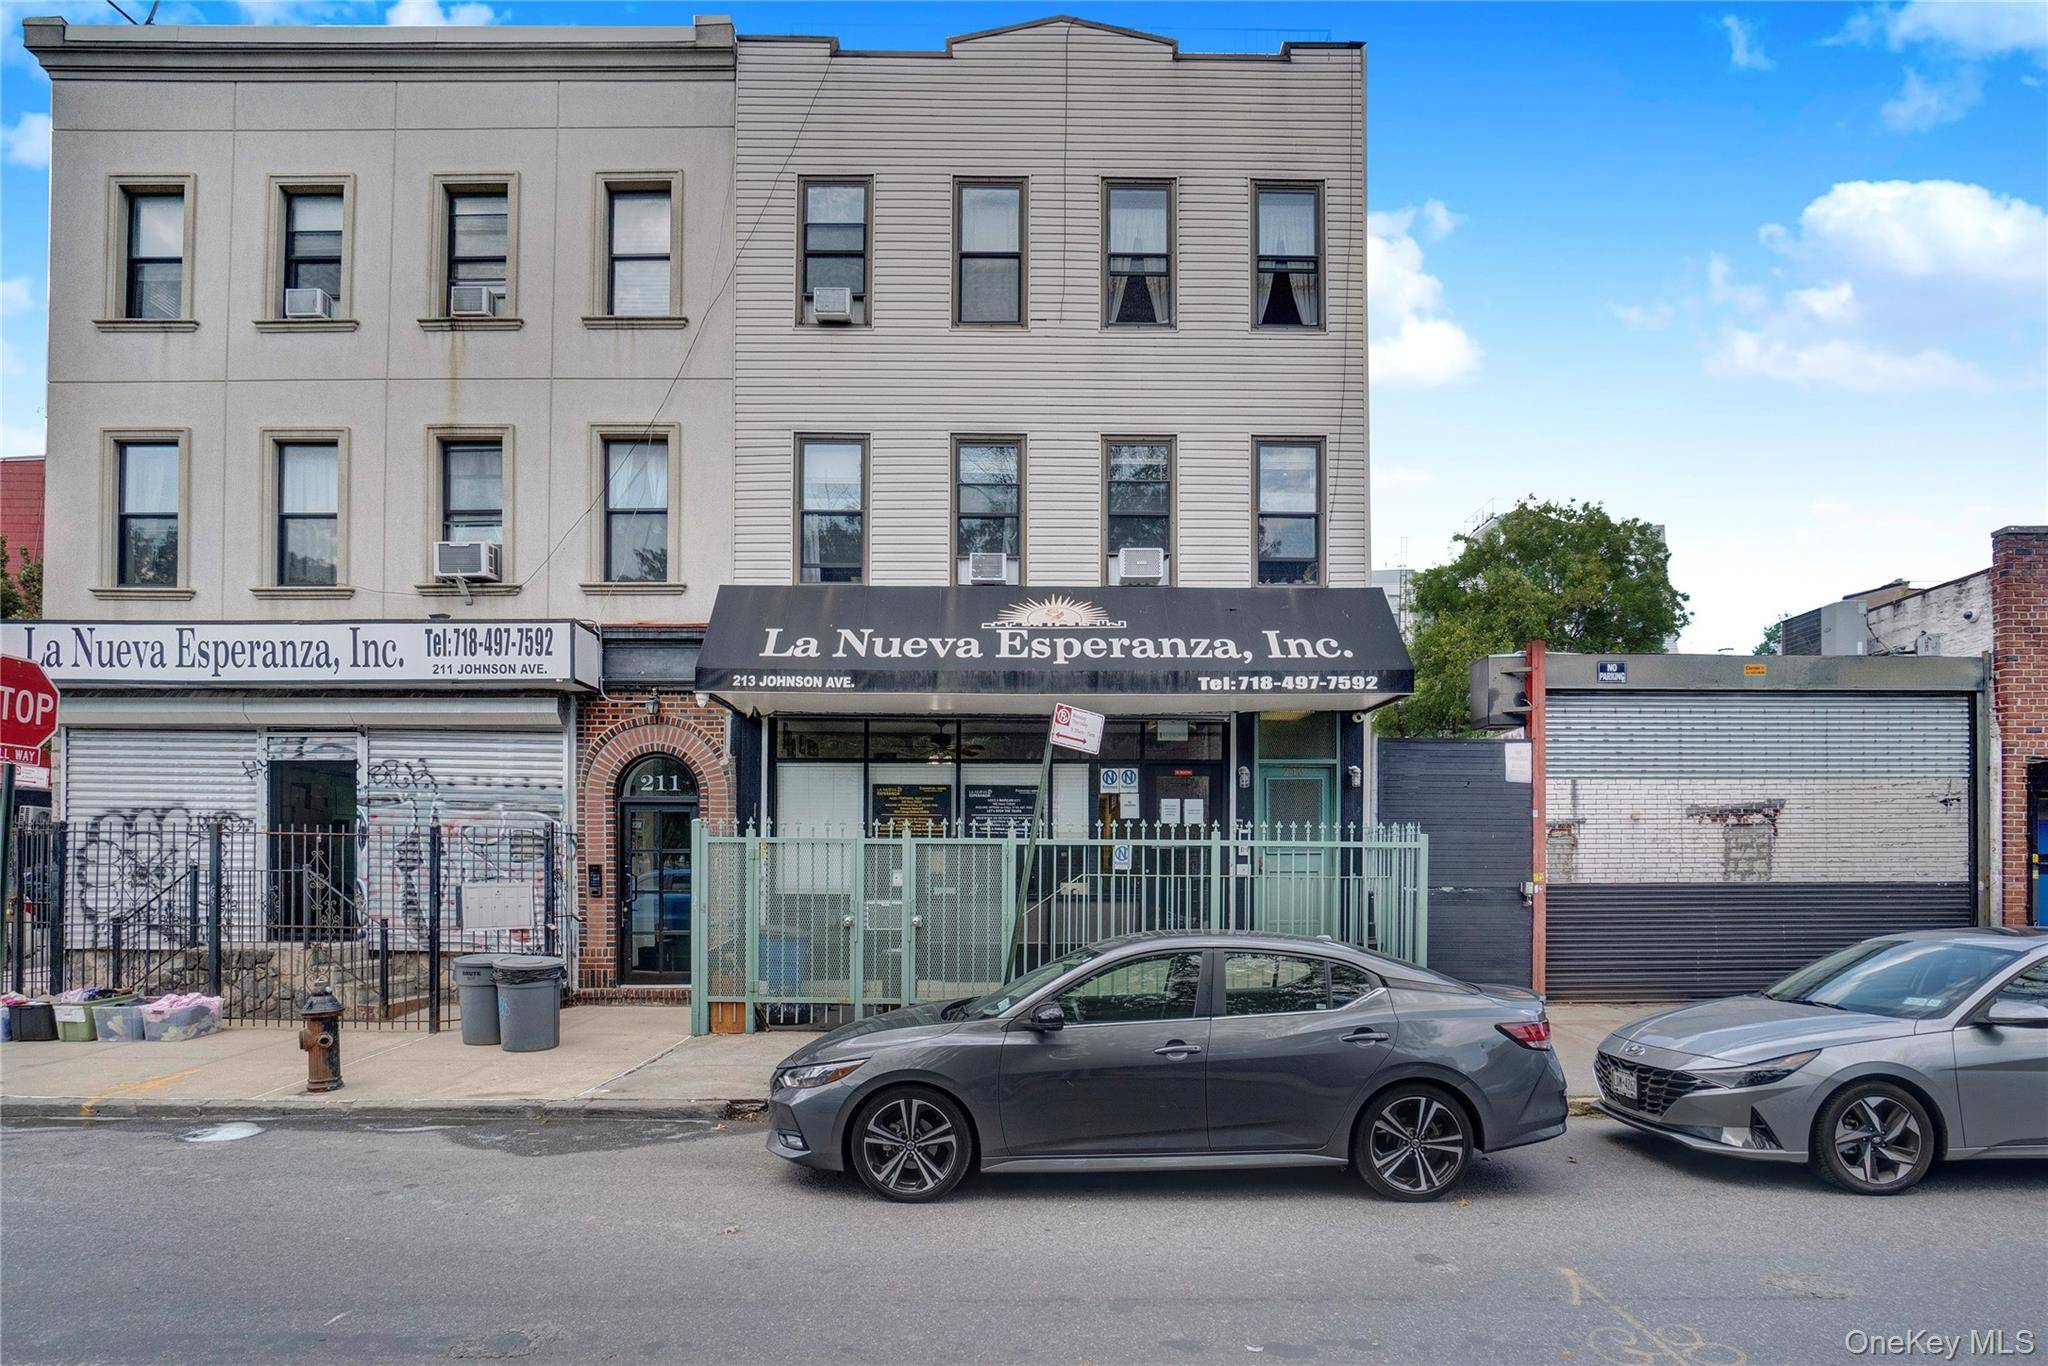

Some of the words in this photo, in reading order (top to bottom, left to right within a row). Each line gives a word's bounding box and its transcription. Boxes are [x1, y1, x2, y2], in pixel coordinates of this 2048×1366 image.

[24, 627, 63, 668] La
[72, 627, 167, 669] Nueva
[176, 627, 340, 677] Esperanza,
[349, 627, 404, 668] Inc.
[759, 628, 821, 658] La
[831, 628, 984, 659] Nueva
[995, 629, 1253, 665] Esperanza,
[1262, 630, 1354, 659] Inc.
[432, 663, 453, 675] 211
[457, 663, 517, 675] JOHNSON
[520, 663, 548, 675] AVE.
[1607, 663, 1618, 672] NO
[732, 675, 756, 687] 213
[759, 675, 823, 689] JOHNSON
[825, 676, 855, 689] AVE.
[1599, 672, 1626, 682] PARKING
[0, 685, 54, 726] TOP
[15, 749, 35, 762] WAY
[640, 774, 681, 792] 211
